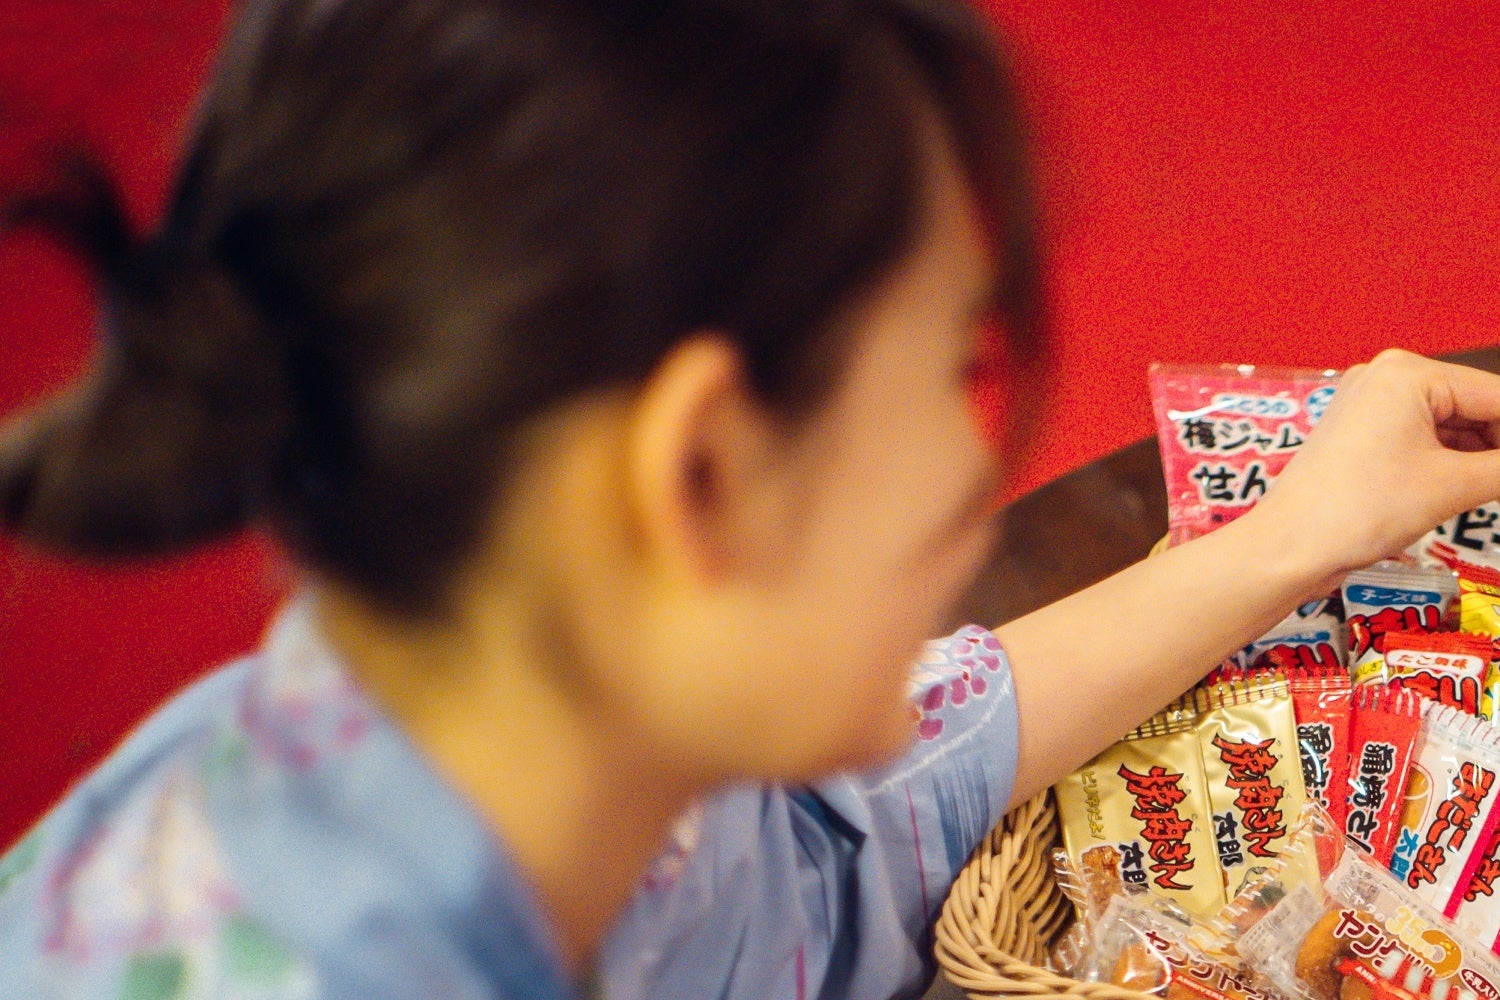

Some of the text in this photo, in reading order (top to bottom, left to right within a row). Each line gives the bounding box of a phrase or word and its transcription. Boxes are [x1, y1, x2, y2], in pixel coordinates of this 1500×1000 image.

[1117, 763, 1196, 890] 焼肉さん
[1211, 733, 1288, 858] 焼肉さん
[1213, 811, 1244, 868] 太郎
